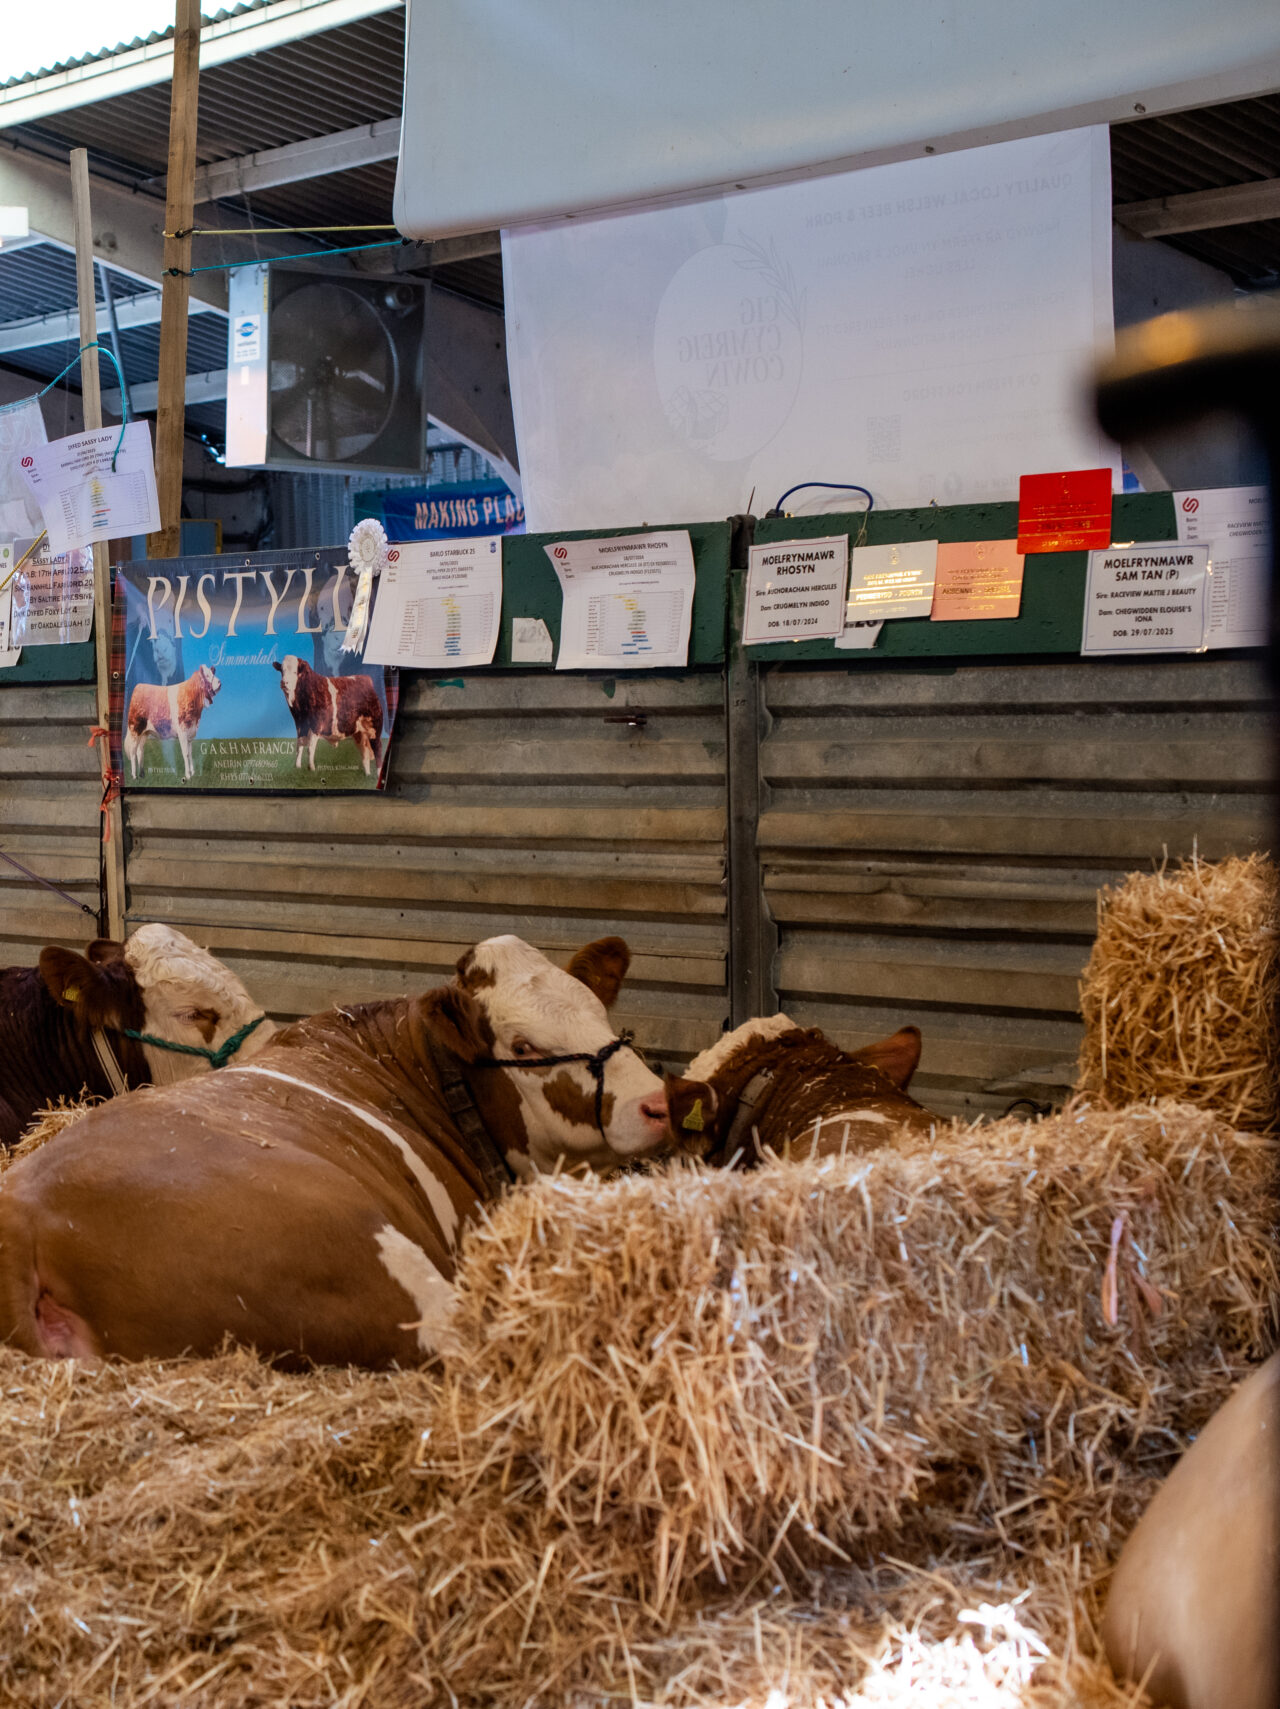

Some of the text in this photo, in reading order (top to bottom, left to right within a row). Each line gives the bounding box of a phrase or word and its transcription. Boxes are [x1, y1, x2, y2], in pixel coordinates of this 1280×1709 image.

[82, 439, 97, 448] SASSY
[415, 498, 478, 530] MAKING
[598, 543, 646, 554] MOELFRYNMAWR
[33, 557, 49, 565] SASSY
[762, 551, 835, 566] MOELFRYNMAWR
[1104, 555, 1194, 569] MOELFRYNMAWR
[777, 565, 815, 576] RHOSYN
[1116, 570, 1179, 582] SAM TAN (P)
[146, 565, 350, 640] PISTYLL
[773, 602, 808, 610] CRUGMELYN
[1115, 607, 1158, 615] CHEGWIDDEN
[1160, 605, 1192, 613] ELOUISE'S
[782, 618, 818, 626] 18/07/2024
[1131, 628, 1173, 636] 29/07/2025
[209, 642, 278, 667] Simmentals
[200, 741, 295, 754] G A & H M FRANCIS
[220, 773, 237, 781] RHYS
